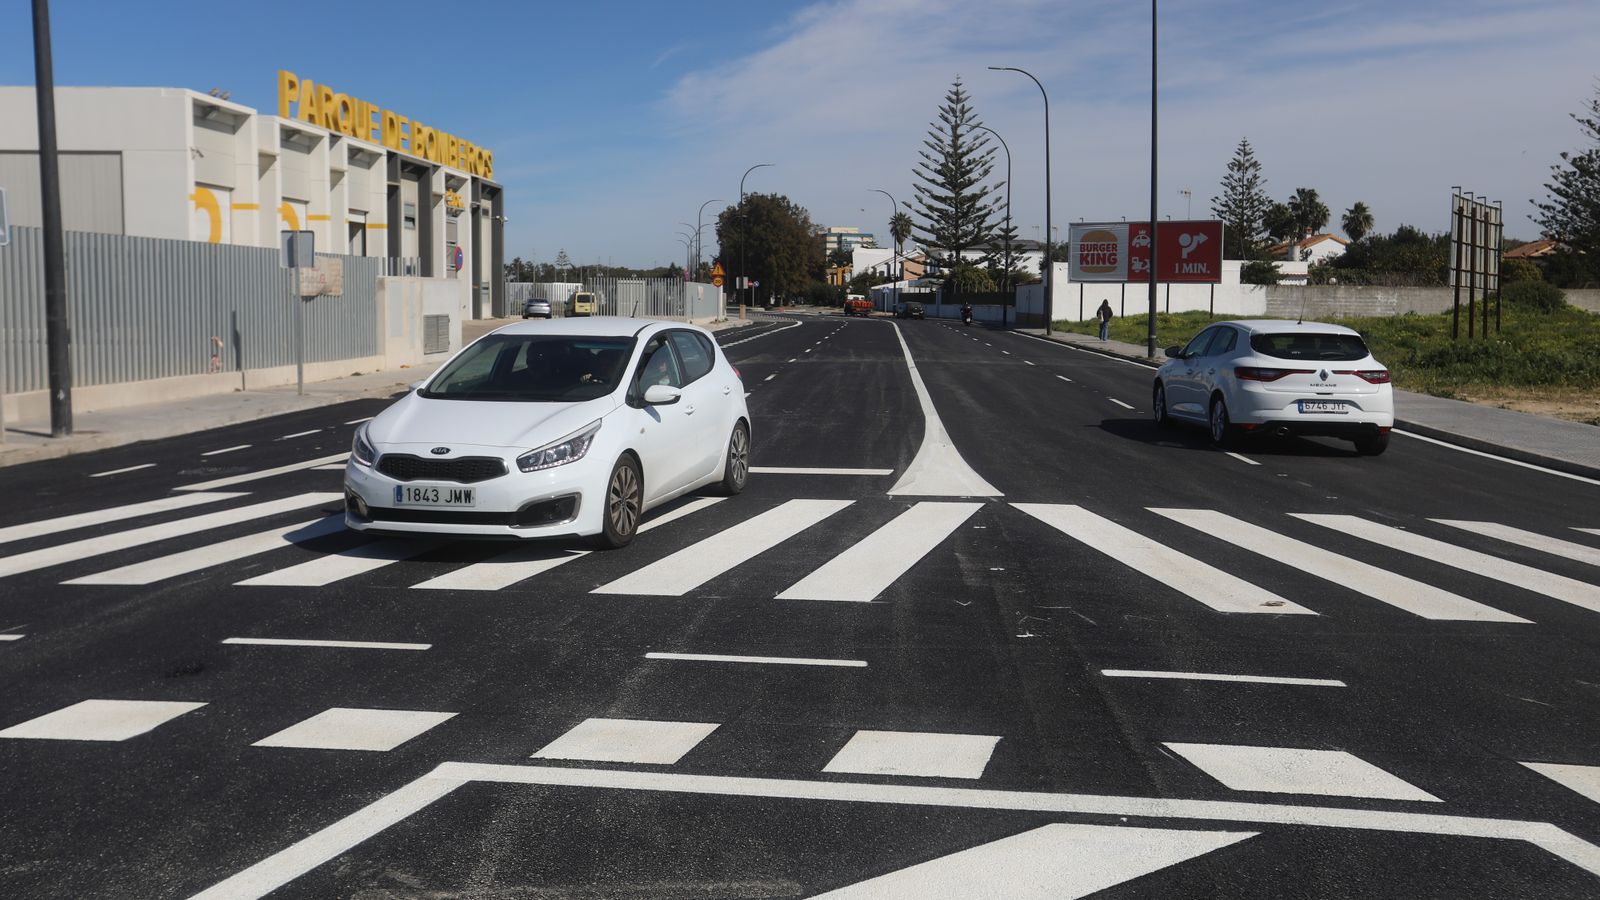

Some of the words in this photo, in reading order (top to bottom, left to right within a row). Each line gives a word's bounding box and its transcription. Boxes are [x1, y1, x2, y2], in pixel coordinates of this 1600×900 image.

[278, 70, 379, 145] PARQUE
[381, 110, 408, 151] DE
[411, 121, 493, 179] BOMBEROS
[1080, 243, 1117, 252] BURGER
[1080, 253, 1117, 266] KING
[1182, 263, 1210, 274] MIN.
[1304, 401, 1328, 410] 6746
[1331, 402, 1346, 410] JYF
[406, 488, 439, 502] 1843
[444, 490, 472, 503] JMW
